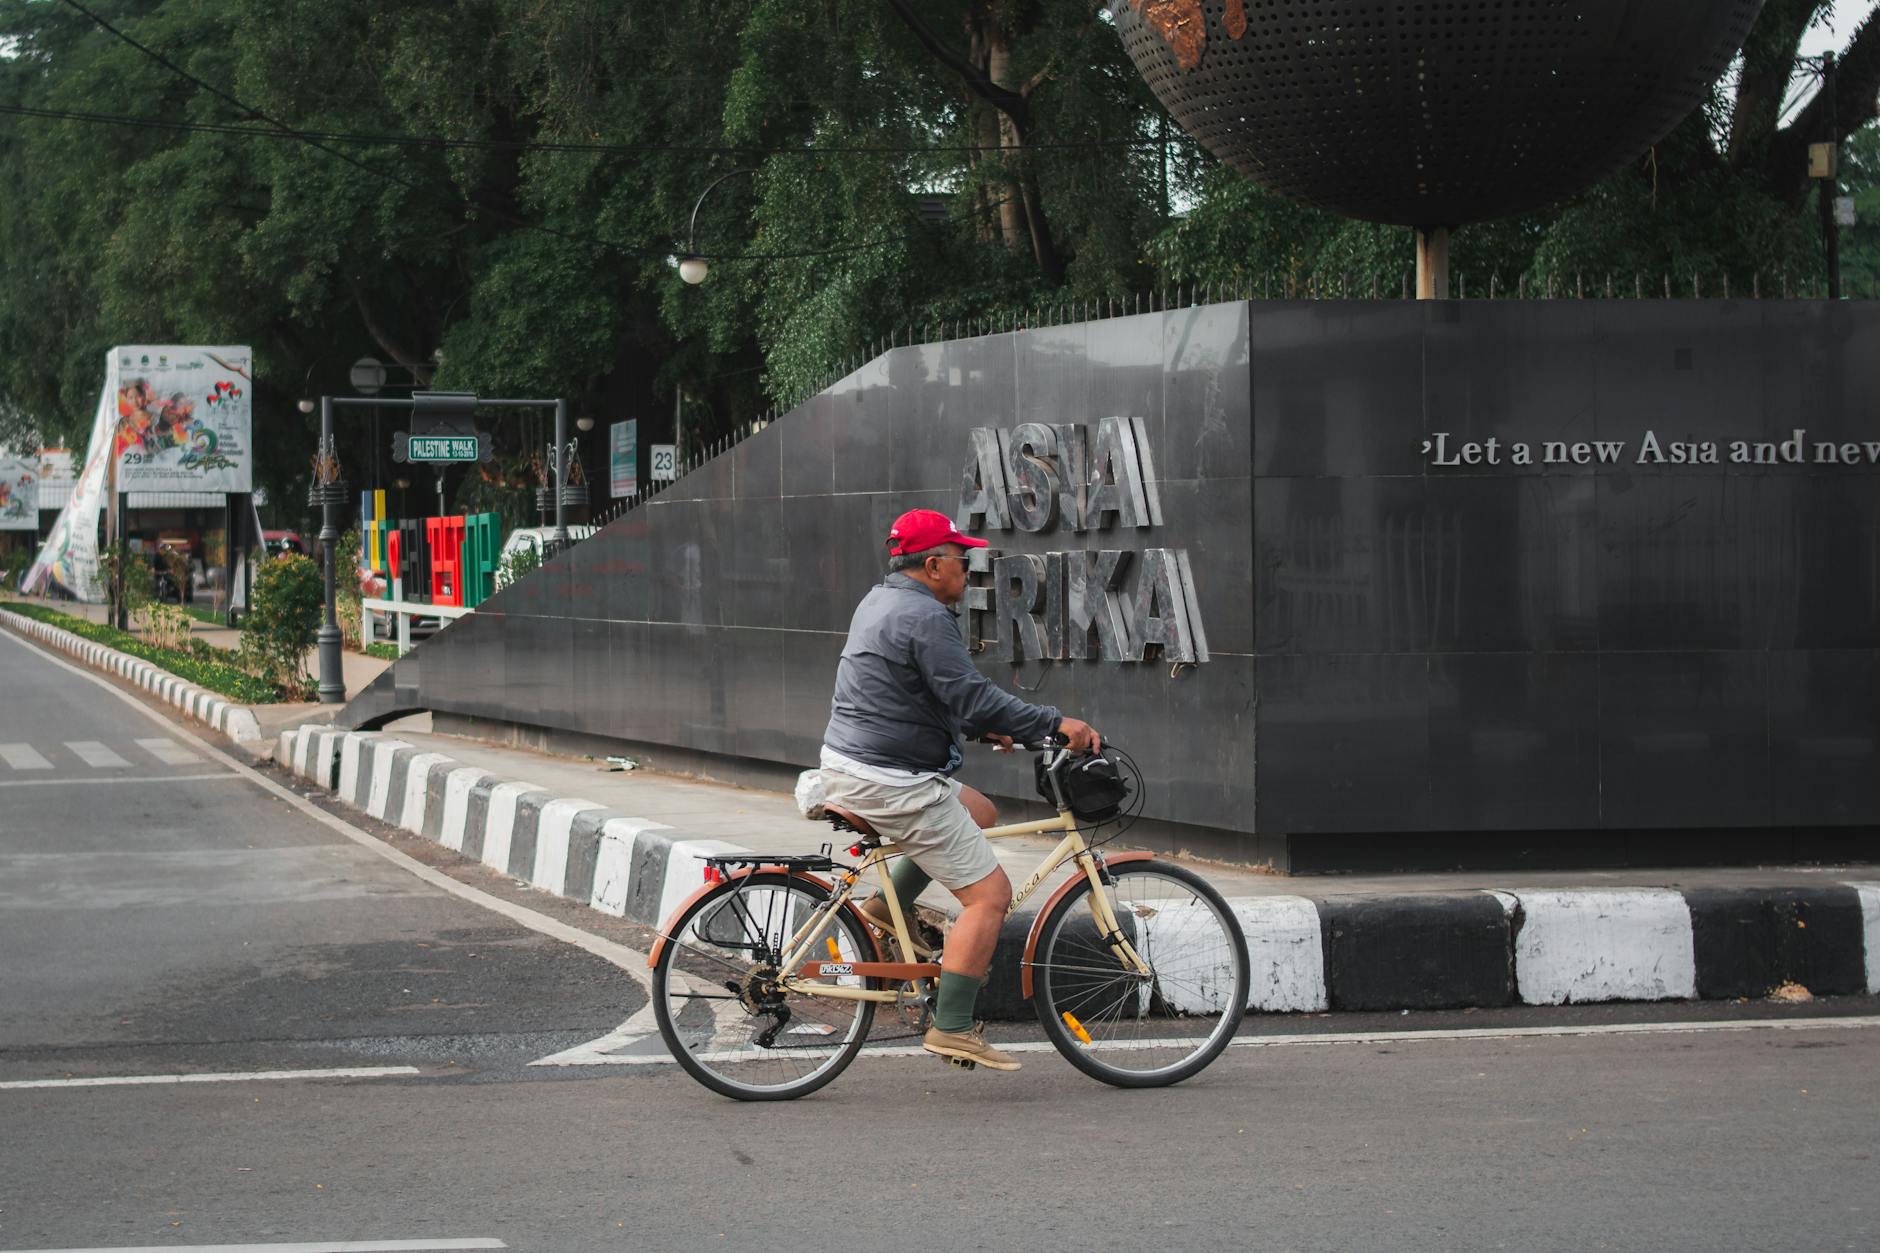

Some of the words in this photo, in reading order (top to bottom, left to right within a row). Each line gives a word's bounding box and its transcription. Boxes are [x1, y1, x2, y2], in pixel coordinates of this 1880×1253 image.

[413, 440, 450, 457] PALESTINE
[451, 440, 474, 450] WALK
[1512, 442, 1533, 465] a
[1542, 441, 1626, 464] new
[1636, 430, 1719, 464] Asia
[1729, 429, 1806, 464] and
[124, 453, 142, 464] 29
[655, 452, 673, 470] 23
[957, 416, 1156, 532] ASIA
